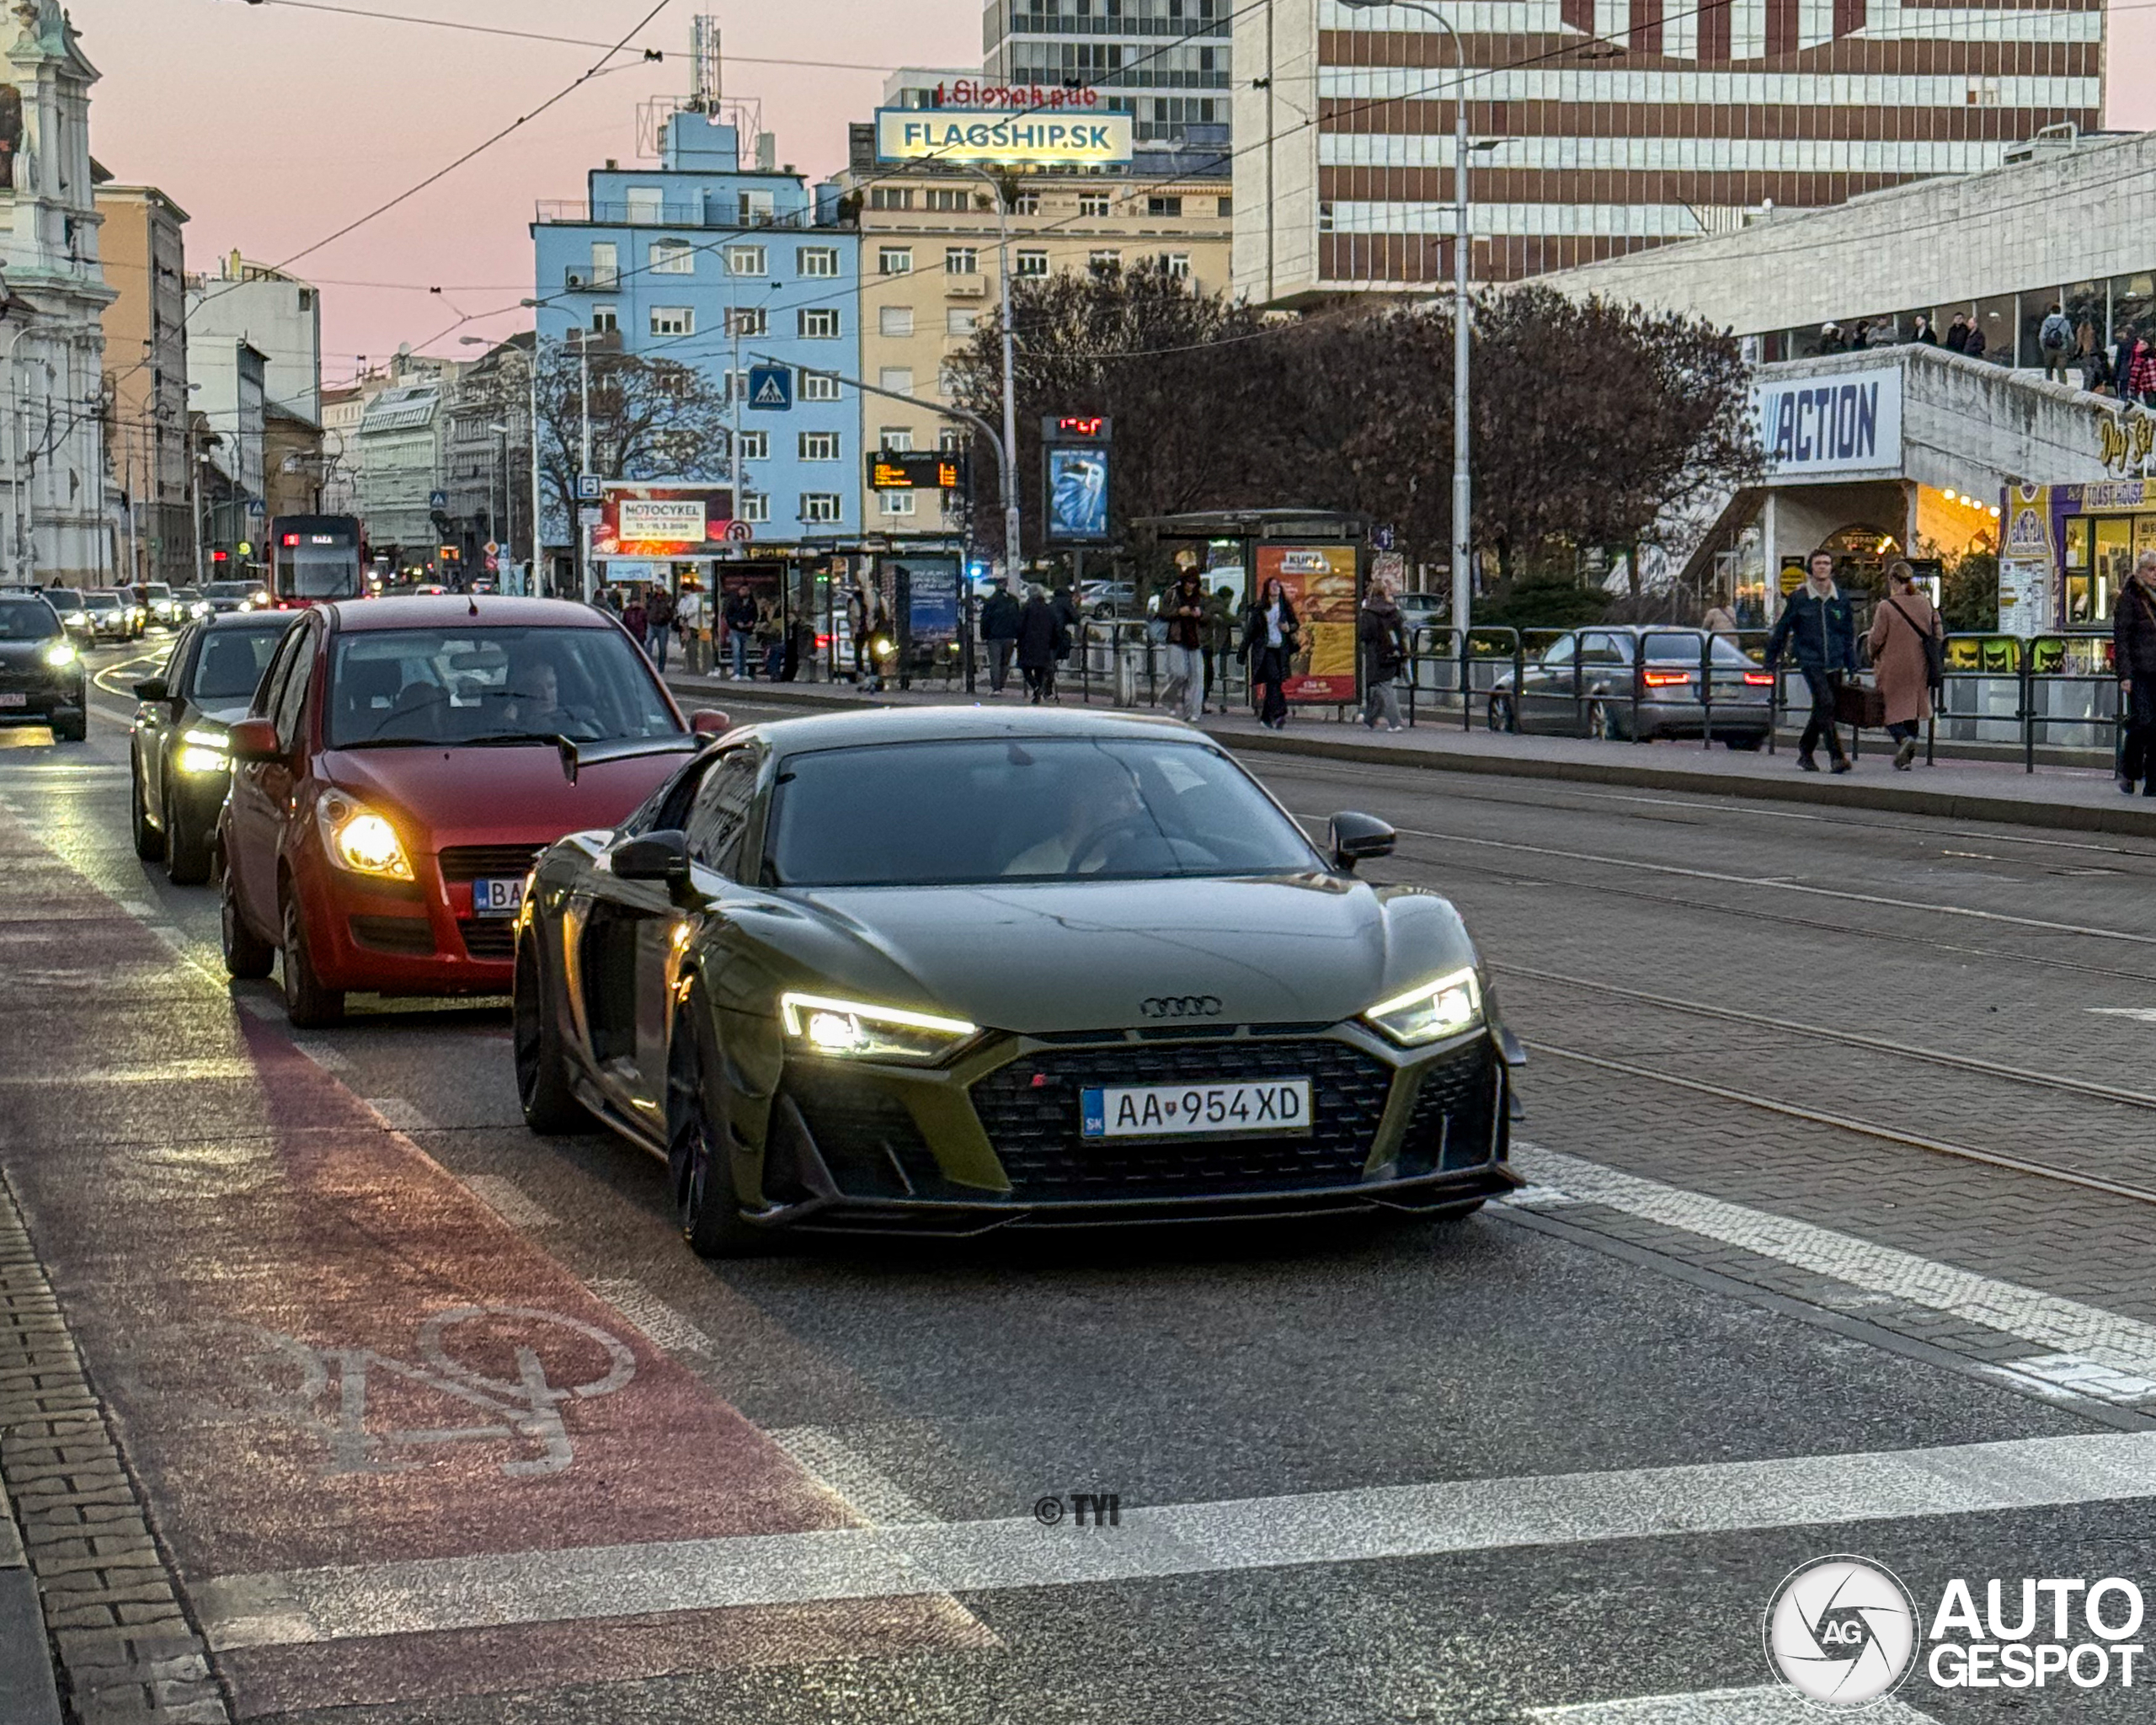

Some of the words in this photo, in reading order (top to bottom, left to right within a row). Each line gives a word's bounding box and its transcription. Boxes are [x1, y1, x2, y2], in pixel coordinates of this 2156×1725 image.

[1051, 85, 1098, 107] pub
[904, 123, 1112, 150] FLAGSHIP.SK
[1776, 382, 1878, 462] ACTION
[626, 505, 699, 515] MOTOCYKEL
[492, 882, 523, 906] BA
[1182, 1087, 1299, 1124] 954XD
[1086, 1117, 1102, 1130] SK
